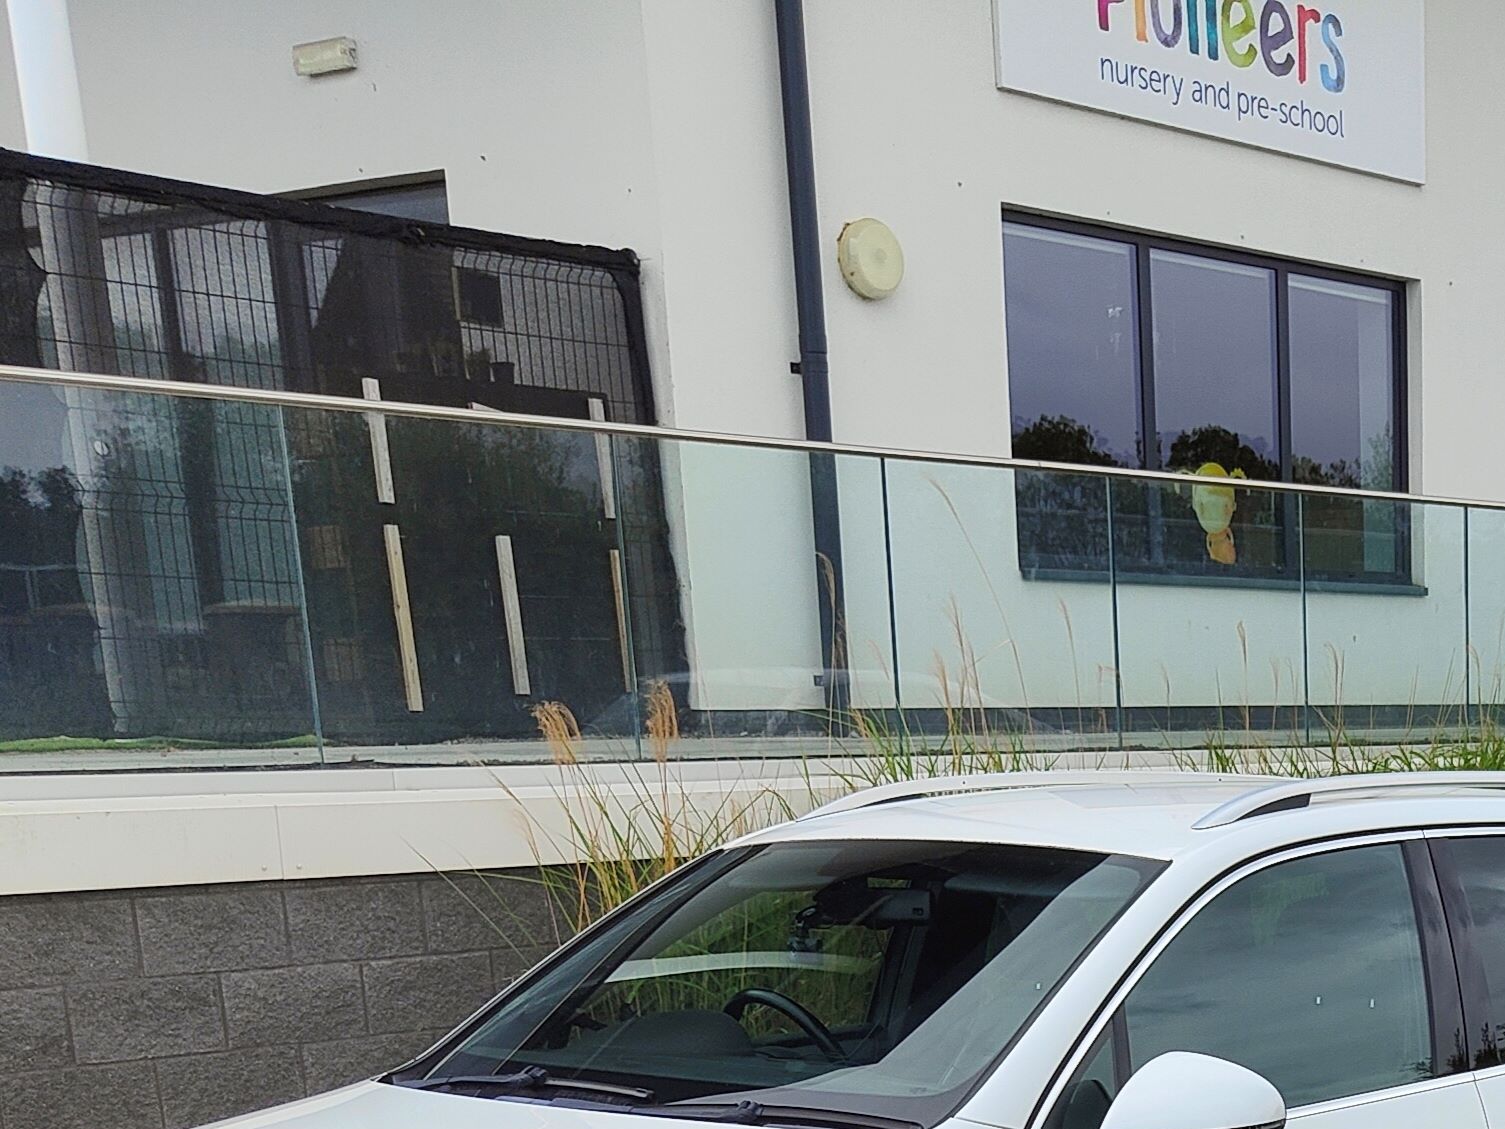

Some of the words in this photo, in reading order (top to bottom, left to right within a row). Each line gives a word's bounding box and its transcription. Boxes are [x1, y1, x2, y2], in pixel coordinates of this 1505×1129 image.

[1097, 0, 1346, 93] oneers
[1100, 57, 1184, 106] nursery
[1191, 81, 1231, 111] and
[1238, 91, 1345, 138] pre-school
